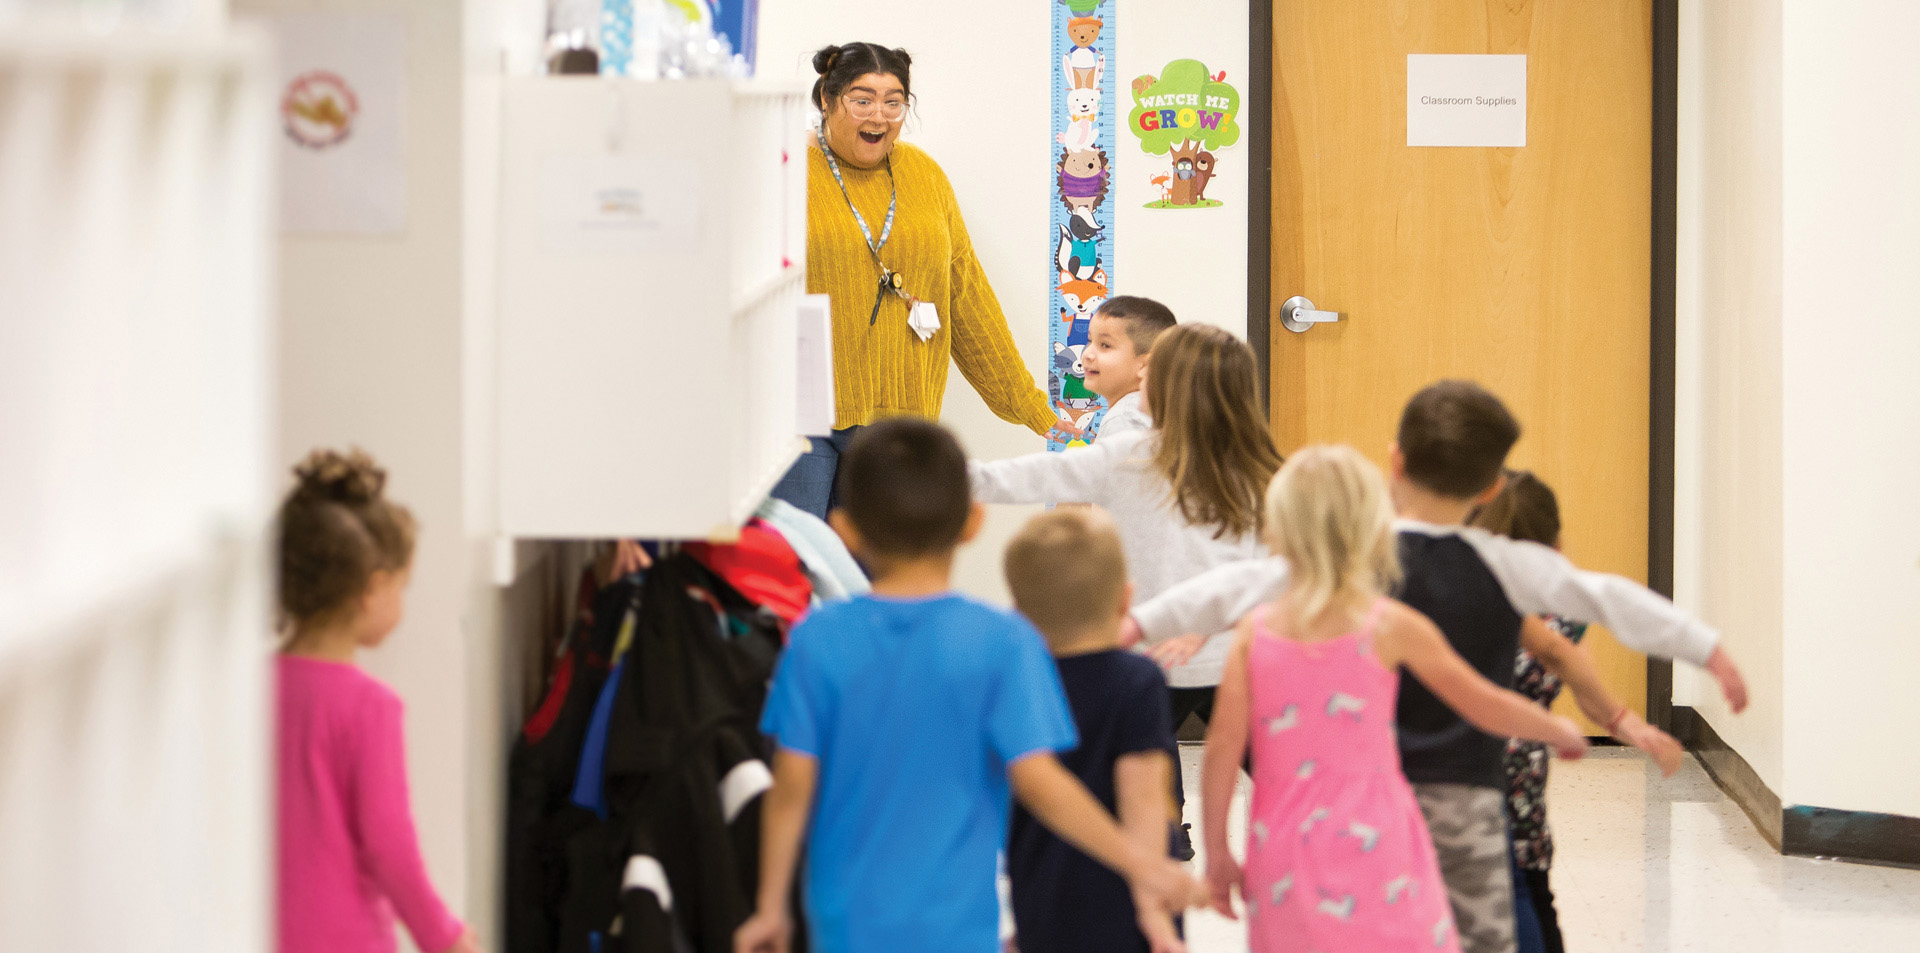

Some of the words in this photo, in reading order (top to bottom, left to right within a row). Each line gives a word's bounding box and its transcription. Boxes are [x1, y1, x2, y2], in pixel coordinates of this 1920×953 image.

[1139, 94, 1198, 108] WATCH
[1205, 94, 1229, 110] ME
[1421, 96, 1472, 105] Classroom
[1475, 96, 1517, 107] Supplies
[1139, 108, 1231, 132] GROW!
